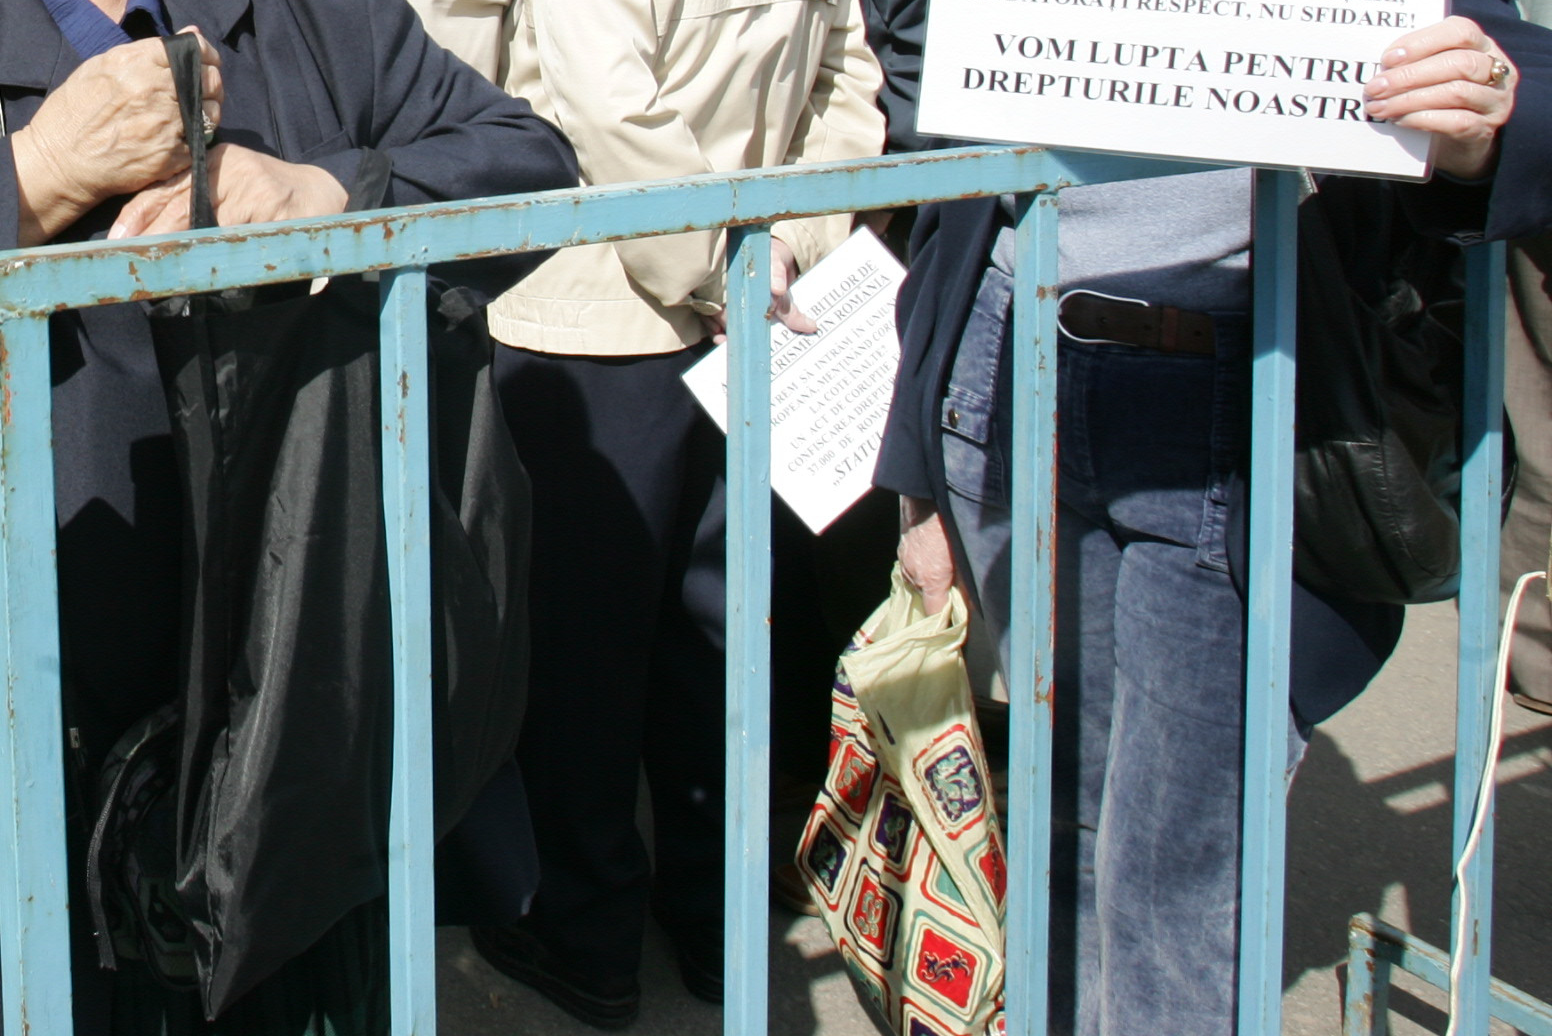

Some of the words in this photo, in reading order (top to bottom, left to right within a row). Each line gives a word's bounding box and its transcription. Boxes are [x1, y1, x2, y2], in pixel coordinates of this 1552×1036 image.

[1258, 3, 1295, 21] NU
[1300, 6, 1416, 29] SFIDARE!
[993, 33, 1079, 62] VOM
[1088, 40, 1210, 72] LUPTA
[1221, 50, 1382, 85] PENTRU
[961, 67, 1195, 108] DREPTURILE
[857, 260, 876, 278] DE
[833, 274, 890, 321] ROMÂNIA
[830, 401, 847, 416] DE
[838, 433, 854, 449] DE
